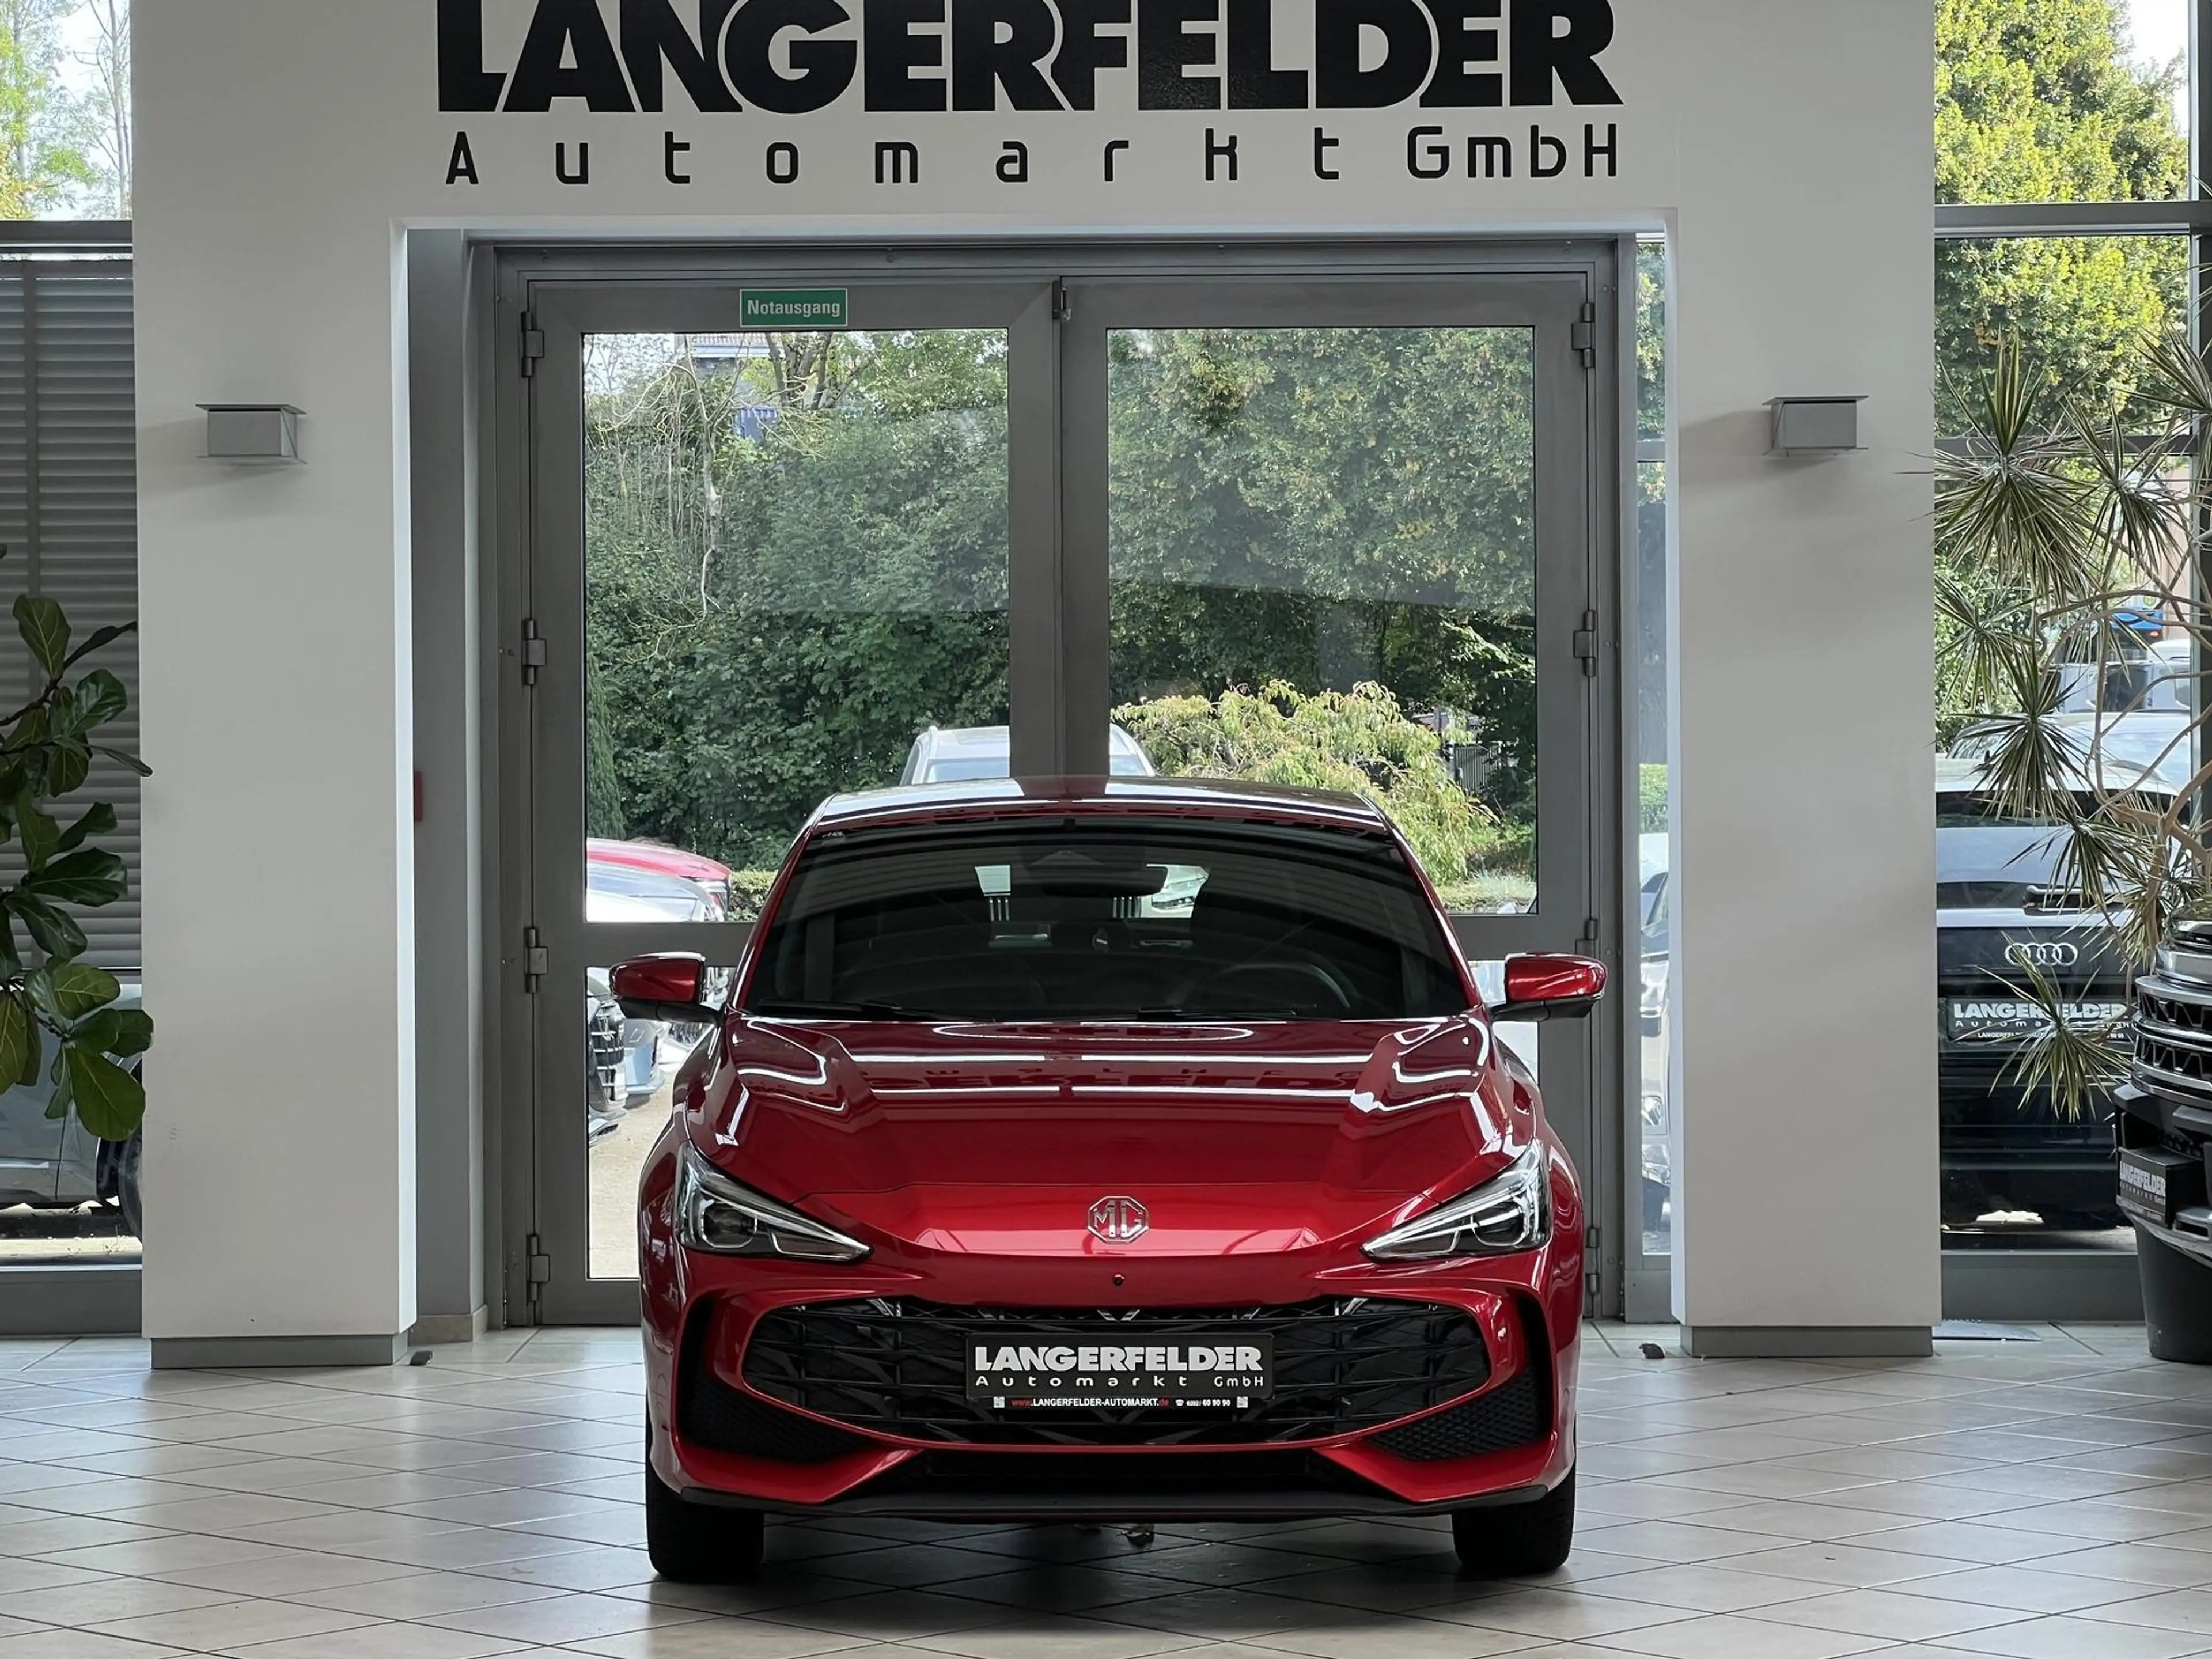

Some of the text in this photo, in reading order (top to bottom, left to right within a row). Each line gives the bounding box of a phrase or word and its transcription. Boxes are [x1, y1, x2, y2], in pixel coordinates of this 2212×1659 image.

[437, 0, 1623, 114] LANGERFELDER
[1407, 123, 1617, 180] GmbH
[747, 299, 840, 317] Notausgang
[1093, 1199, 1143, 1238] MG
[975, 1346, 1263, 1372] LANGERFELDER
[1213, 1375, 1264, 1387] GmbH
